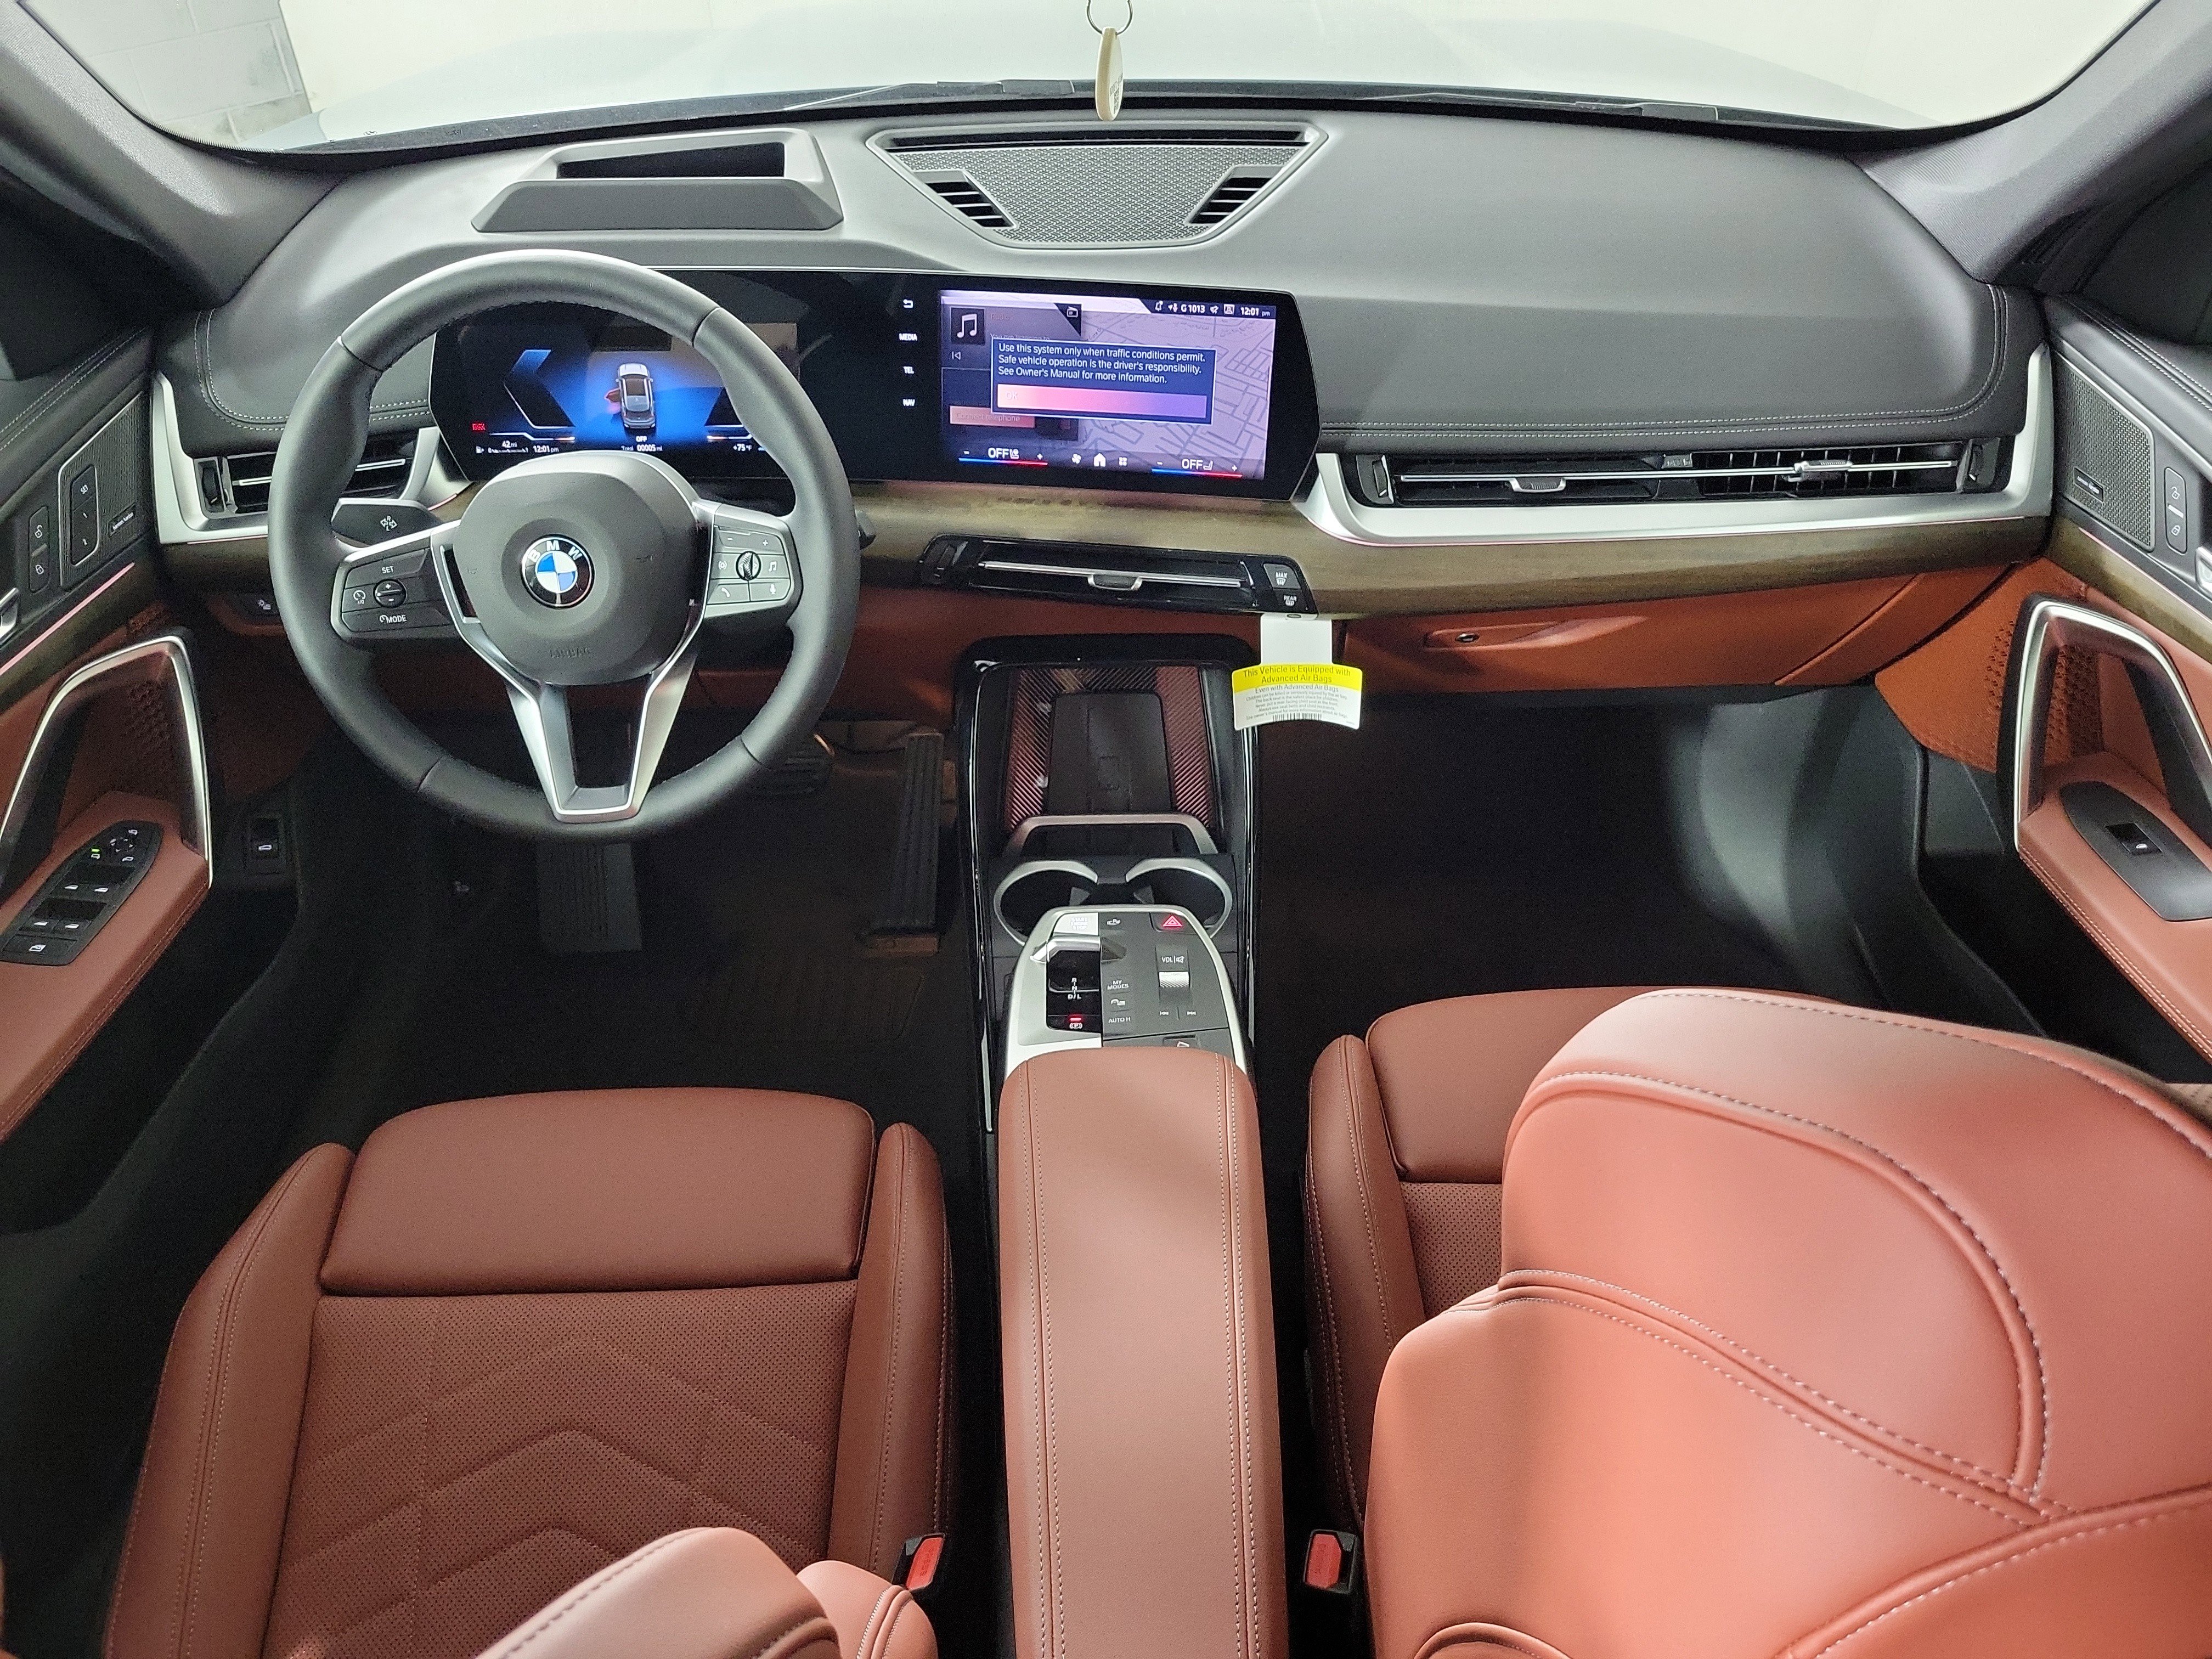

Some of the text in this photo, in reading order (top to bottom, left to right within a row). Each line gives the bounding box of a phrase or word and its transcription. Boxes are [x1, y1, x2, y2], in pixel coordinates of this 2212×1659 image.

[1188, 304, 1205, 313] 1013
[1240, 307, 1260, 316] 12:01
[899, 332, 918, 341] MEDIA
[998, 342, 1205, 363] Use this system only when traffic conditions permit.
[998, 354, 1202, 375] Safe vehicle operation is the driver's responsibility.
[903, 366, 915, 374] TEL
[998, 366, 1167, 383] See Owner's Manual for more information.
[1005, 391, 1019, 400] OK
[902, 398, 915, 407] NAV
[502, 440, 511, 448] 42
[988, 447, 1009, 459] OFF
[1181, 458, 1204, 470] OFF
[527, 540, 583, 563] BMW
[381, 565, 394, 574] SET
[386, 614, 408, 624] MODE
[1244, 669, 1258, 678] This
[1260, 665, 1288, 675] Vehicle
[1297, 665, 1334, 674] Equipped
[1335, 668, 1351, 676] with
[1261, 674, 1299, 684] Advanced
[1313, 674, 1332, 684] Bags
